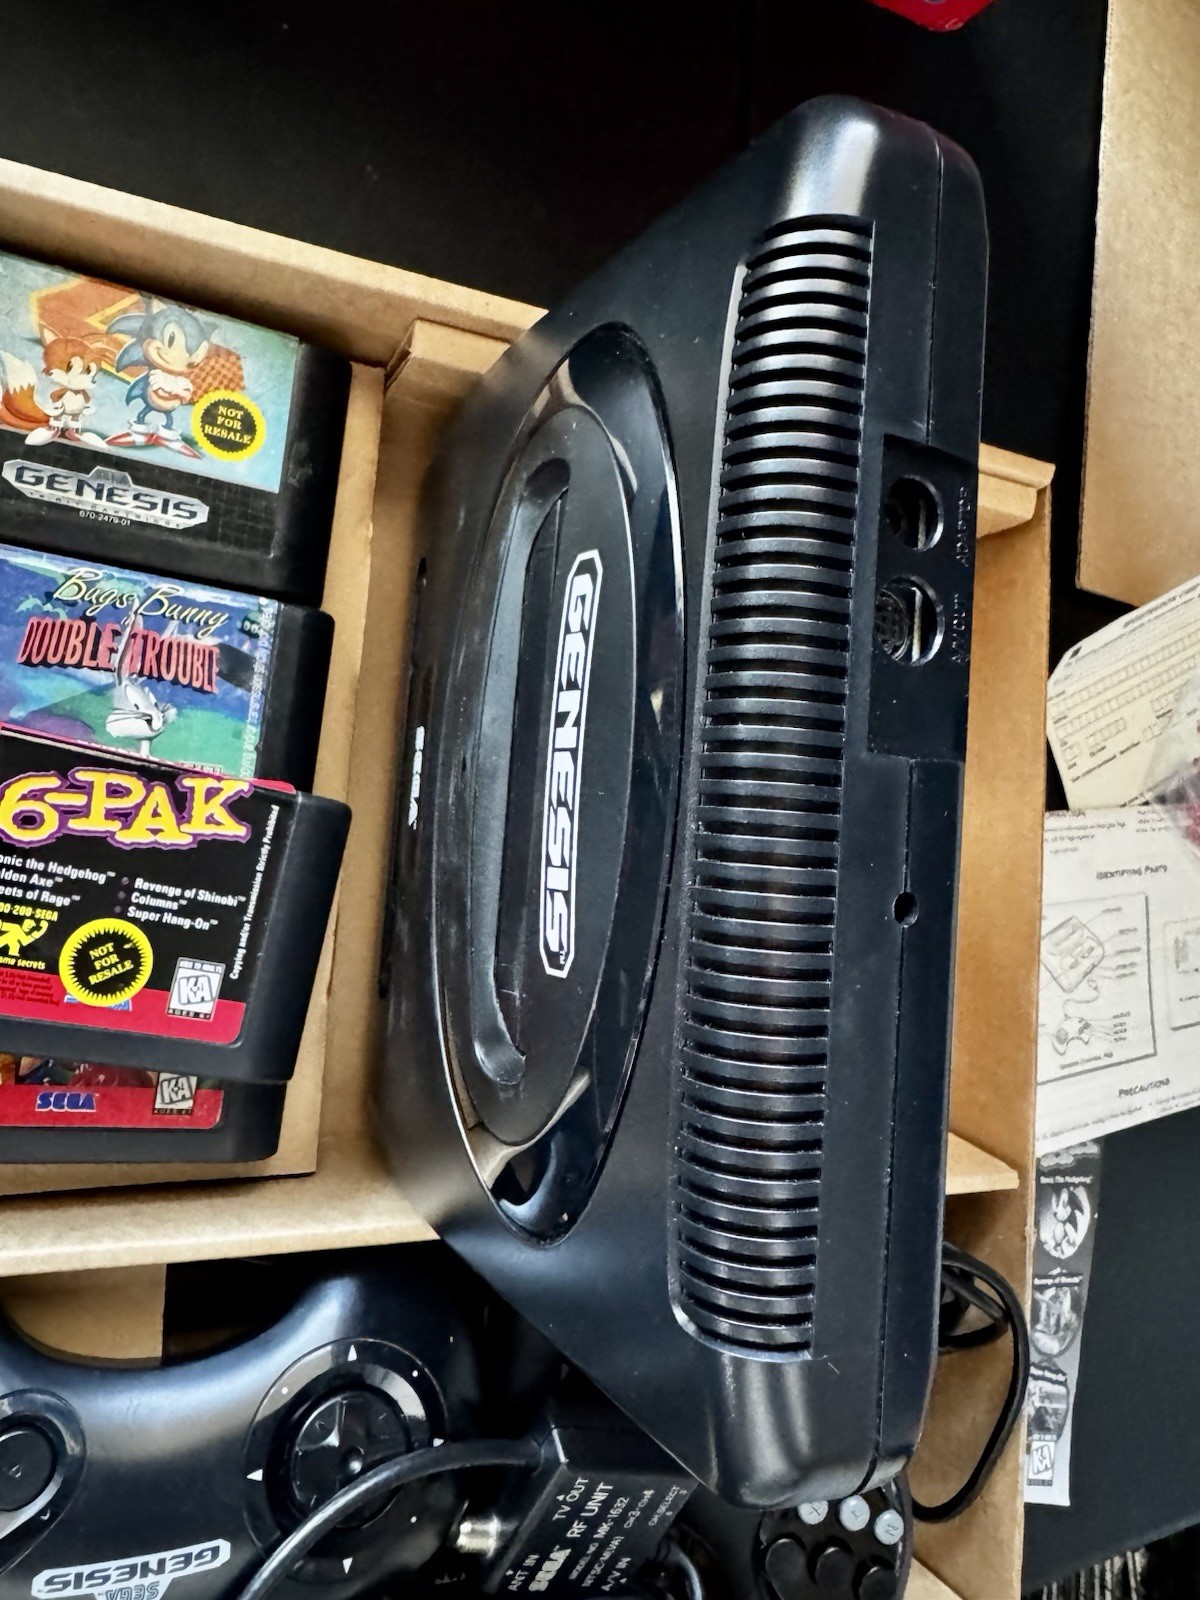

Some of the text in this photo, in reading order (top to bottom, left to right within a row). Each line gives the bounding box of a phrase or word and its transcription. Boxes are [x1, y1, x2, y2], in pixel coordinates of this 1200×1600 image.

[216, 416, 241, 430] FOR
[218, 405, 243, 419] NOT
[204, 424, 252, 444] RESALE
[14, 465, 198, 520] GENESIS
[53, 567, 229, 639] Bugs Bunny
[17, 615, 221, 695] DOUBLE TROUBLE
[546, 572, 594, 953] GENESIS
[0, 767, 252, 847] 6-PAK
[25, 857, 45, 871] the
[47, 861, 108, 885] Hedgehog
[29, 873, 54, 888] Axe
[25, 889, 40, 900] of
[40, 890, 71, 907] Rage
[131, 891, 179, 910] Columns
[134, 877, 239, 907] Revenge of Shinobi
[127, 905, 211, 930] Super Hang-On
[89, 942, 115, 960] NOT
[93, 953, 120, 970] FOR
[17, 958, 46, 970] secrets
[88, 960, 134, 985] RESALE
[35, 1091, 97, 1112] SEGA
[552, 1476, 589, 1521] TV OUT
[566, 1481, 614, 1538] RF UNIT
[44, 1544, 221, 1594] GENESIS
[522, 1553, 540, 1567] IN
[105, 1580, 160, 1600] SEGA
